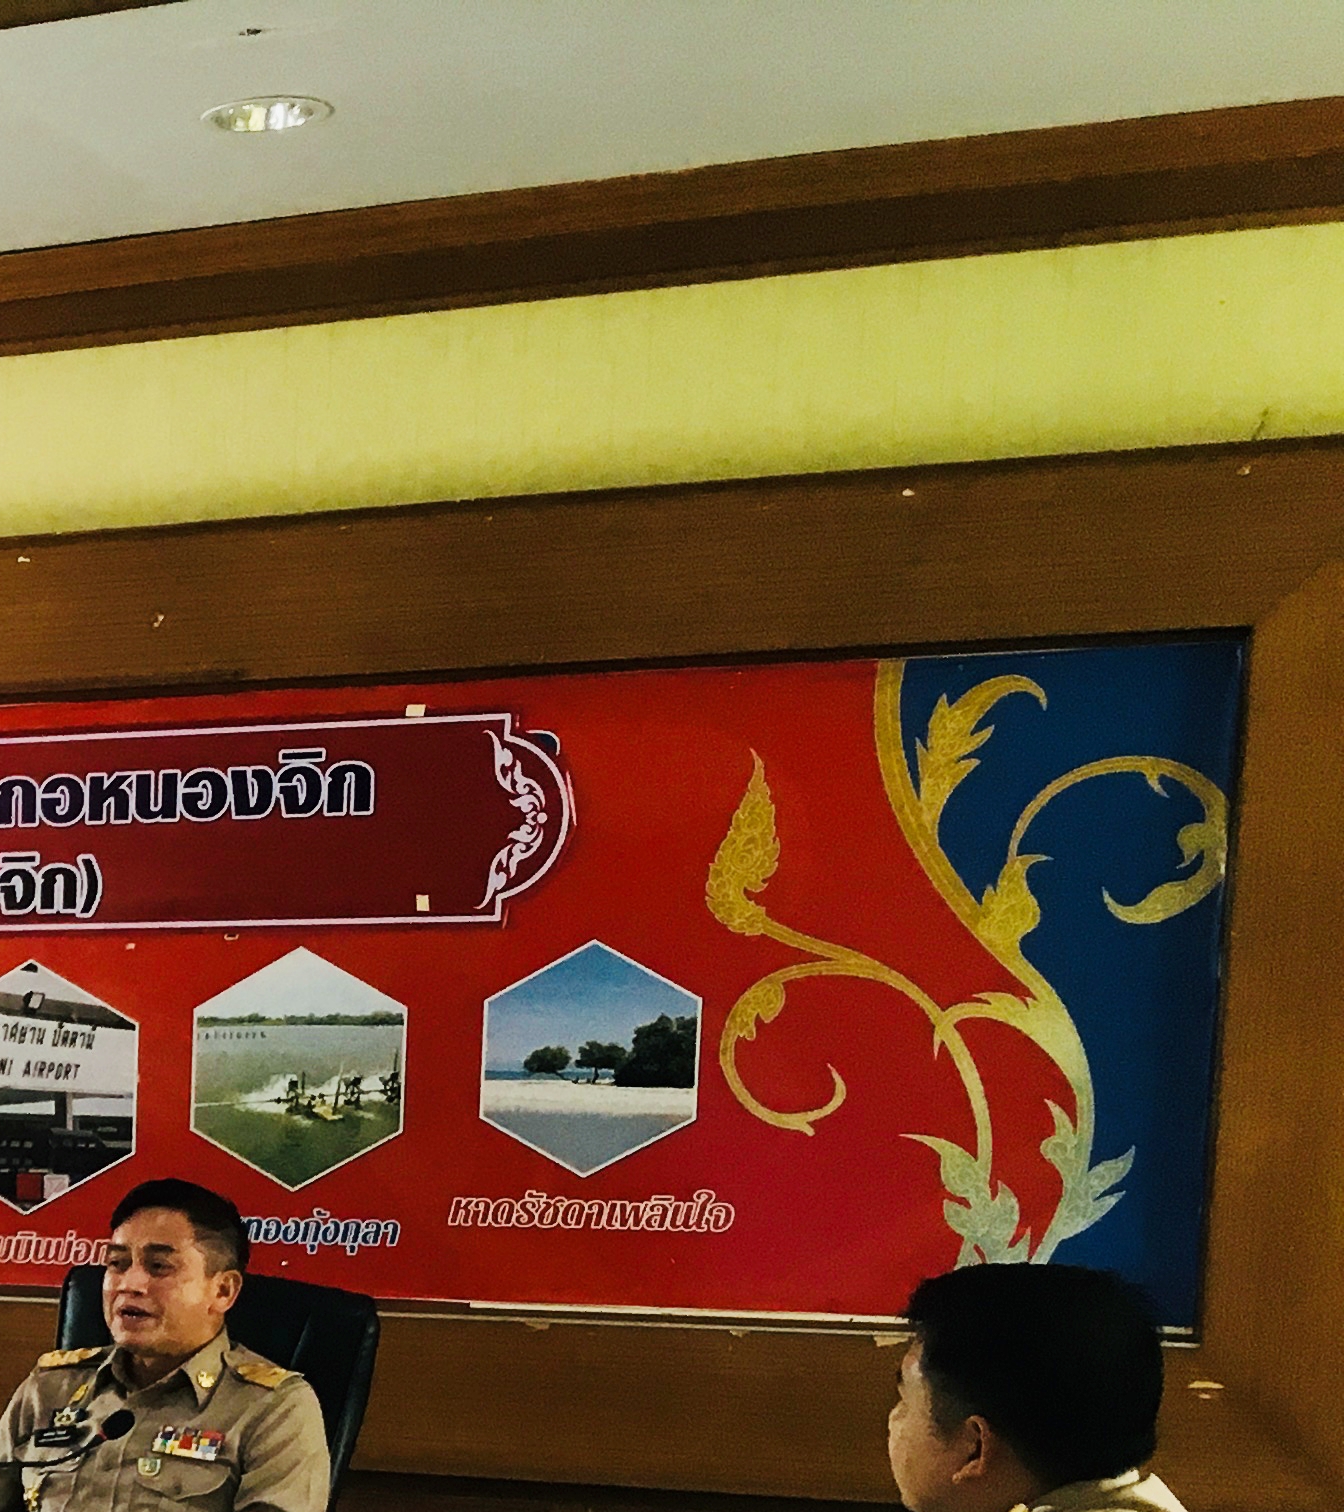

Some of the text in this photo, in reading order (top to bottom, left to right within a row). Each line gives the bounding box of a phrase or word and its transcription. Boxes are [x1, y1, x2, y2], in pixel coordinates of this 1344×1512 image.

[22, 1060, 81, 1080] AIRPORT
[240, 1208, 400, 1256] ทองกุ้งกุลา
